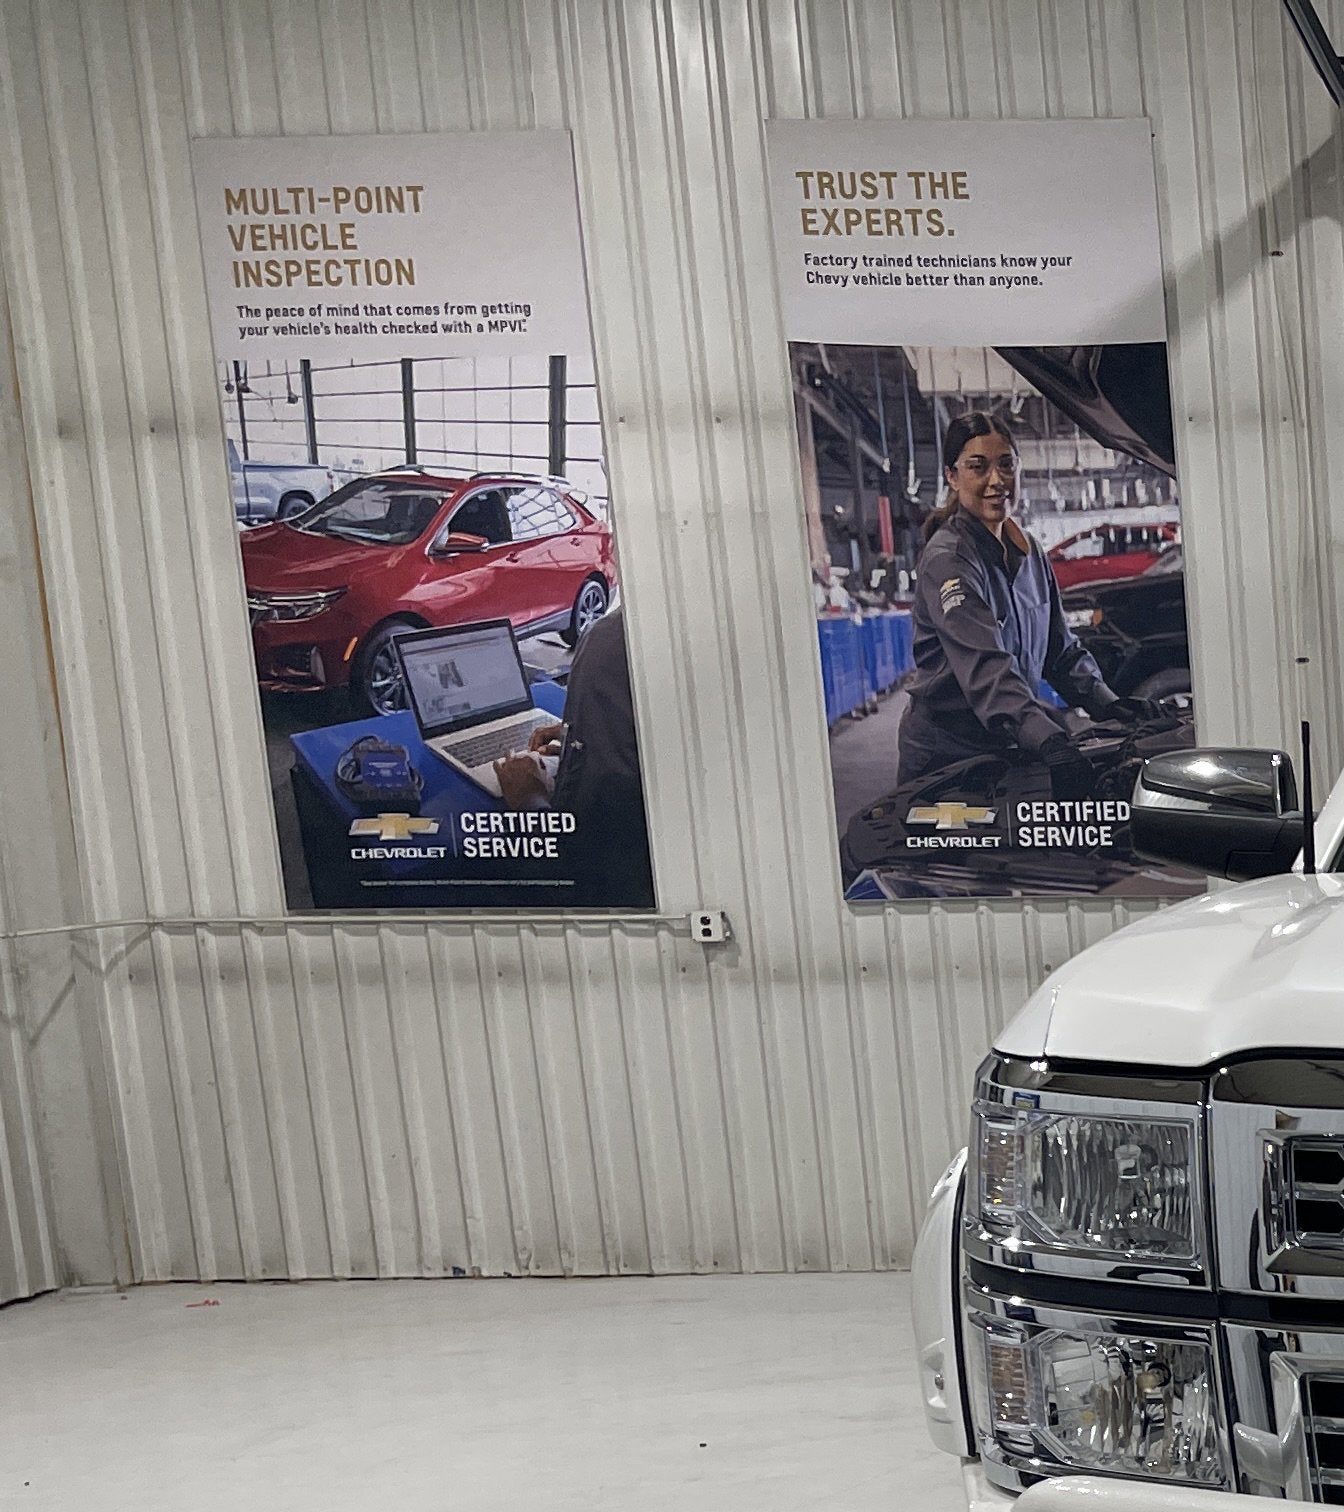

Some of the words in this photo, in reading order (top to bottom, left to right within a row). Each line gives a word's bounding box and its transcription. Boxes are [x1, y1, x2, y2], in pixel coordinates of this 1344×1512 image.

[795, 171, 898, 200] TRUST
[907, 171, 970, 200] THE
[224, 186, 424, 216] MULTI-POINT
[800, 208, 955, 237] EXPERTS.
[227, 223, 359, 252] VEHICLE
[804, 252, 858, 270] Factory
[862, 253, 913, 268] trained
[916, 253, 997, 268] technicians
[1001, 253, 1037, 268] know
[1041, 255, 1073, 270] your
[233, 258, 416, 288] INSPECTION
[806, 271, 849, 287] Chevy
[852, 271, 902, 287] vehicle
[905, 272, 950, 287] better
[954, 272, 985, 286] than
[989, 274, 1043, 289] anyone.
[236, 304, 262, 318] The
[265, 306, 305, 321] peace
[309, 303, 323, 317] of
[326, 303, 360, 317] mind
[363, 303, 393, 317] that
[396, 304, 440, 316] comes
[444, 302, 478, 316] from
[481, 302, 532, 318] getting
[238, 325, 269, 340] your
[273, 321, 331, 336] vehicle's
[334, 321, 378, 335] health
[381, 320, 438, 334] checked
[441, 319, 472, 334] with
[476, 323, 485, 334] a
[460, 812, 576, 833] CERTIFIED
[1016, 801, 1131, 823] CERTIFIED
[906, 836, 1002, 848] CHEVROLET
[1018, 826, 1114, 847] SERVICE
[350, 846, 447, 859] CHEVROLET
[463, 837, 560, 858] SERVICE
